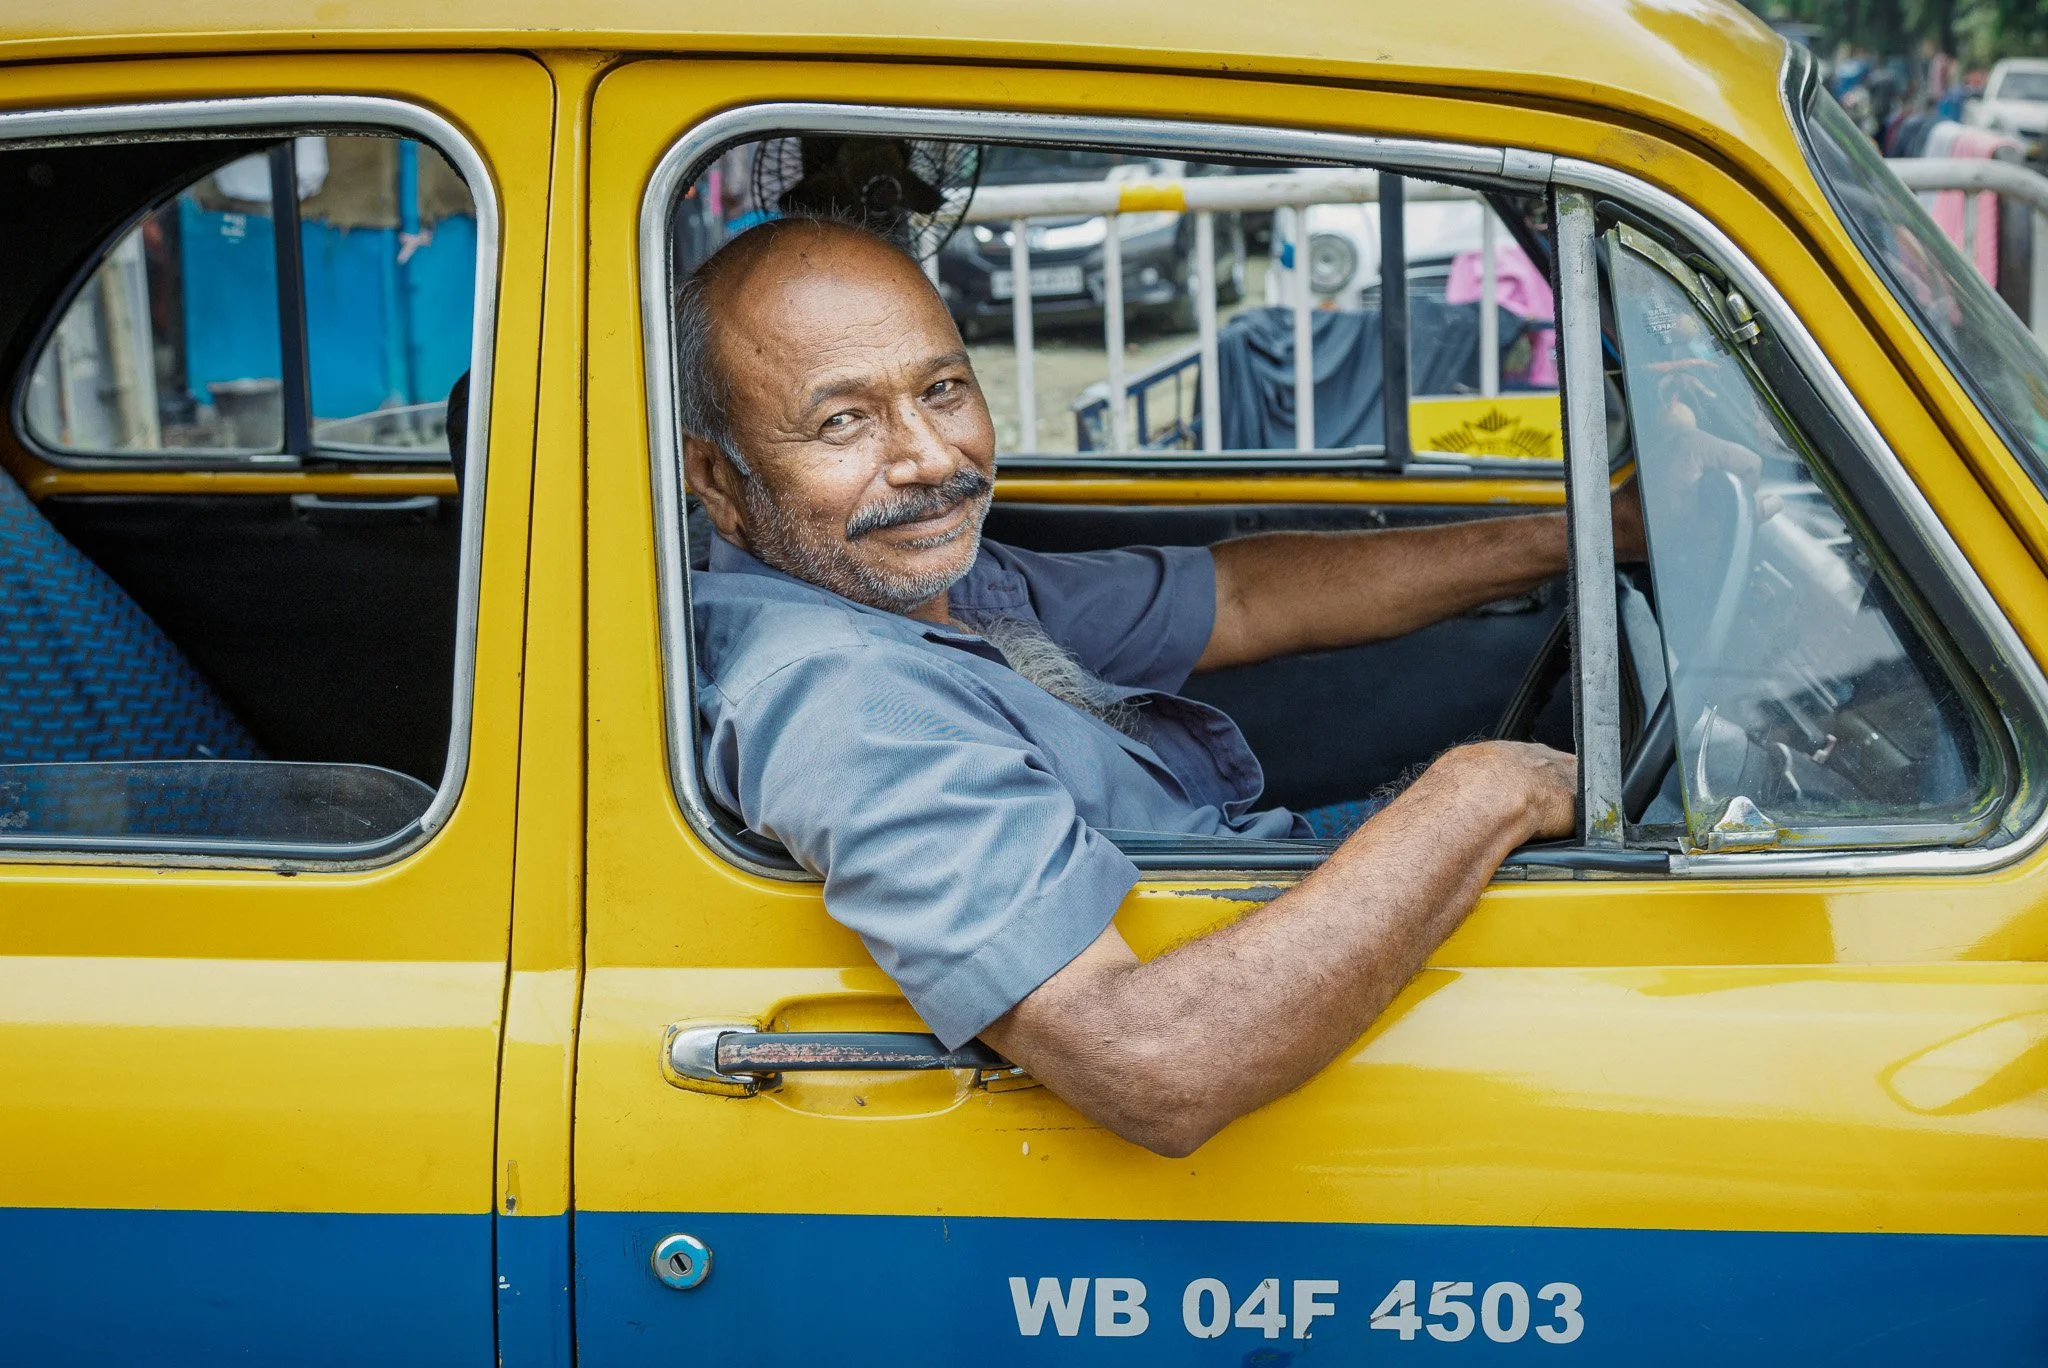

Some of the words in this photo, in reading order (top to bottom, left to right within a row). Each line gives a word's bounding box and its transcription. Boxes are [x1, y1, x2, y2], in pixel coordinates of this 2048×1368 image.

[1008, 1276, 1150, 1337] WB
[1181, 1277, 1340, 1340] 04F
[1369, 1279, 1585, 1344] 4503
